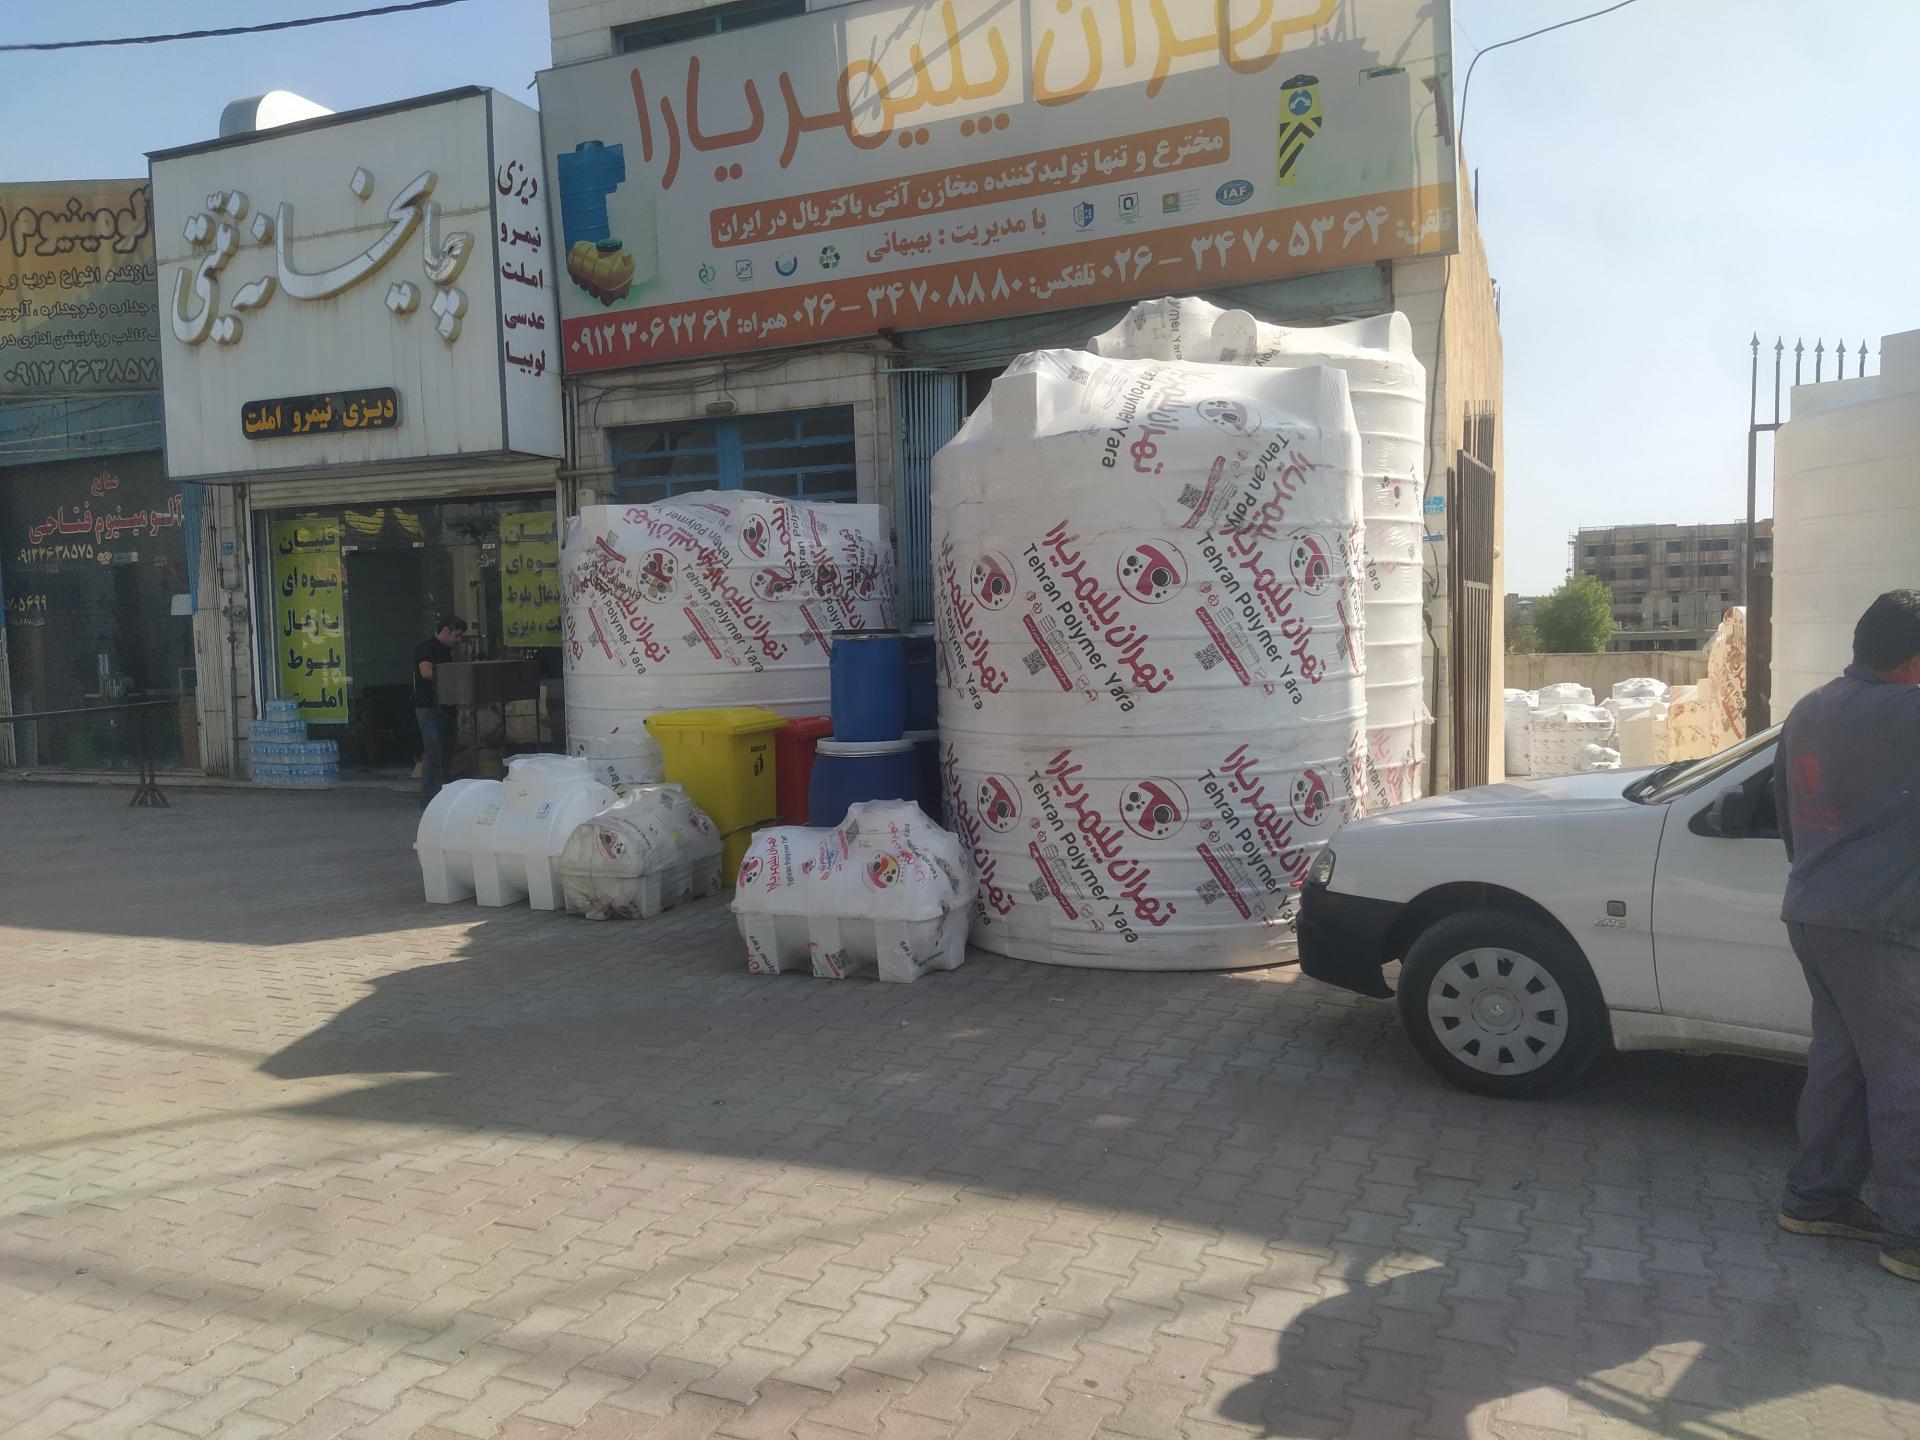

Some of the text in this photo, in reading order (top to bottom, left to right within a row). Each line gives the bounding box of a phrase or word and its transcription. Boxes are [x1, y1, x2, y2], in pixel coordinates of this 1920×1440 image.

[630, 55, 765, 190] یارا
[1093, 143, 1128, 173] تنها
[1135, 153, 1147, 172] و
[1152, 127, 1225, 171] مخترع
[497, 159, 539, 200] دیزی
[916, 176, 979, 210] مخازن
[1223, 184, 1249, 200] IAF
[791, 193, 863, 230] باکتریال
[868, 181, 909, 218] آنتی
[500, 220, 542, 249] نیمرو
[717, 210, 762, 243] ایران
[766, 214, 789, 236] در
[866, 207, 1047, 263] با مدیریت بهبهانی
[22, 271, 56, 290] درب
[60, 265, 101, 290] انواع
[502, 261, 544, 290] املت
[0, 299, 32, 322] آلومی
[110, 299, 149, 317] جداره
[504, 311, 546, 332] عدسی
[1168, 299, 1181, 333] ymer
[18, 331, 52, 349] اداری
[53, 329, 101, 349] پارتیشن
[111, 328, 147, 346] کاذب
[59, 356, 158, 385] ۲۶۳۸۵۷
[505, 340, 547, 377] لوبیا
[1255, 347, 1281, 367] Poly
[245, 397, 395, 434] دیزی نیمرو املت
[1101, 381, 1153, 470] Polymer Yara
[1129, 411, 1180, 475] تهران
[90, 471, 120, 497] صنایع
[1225, 433, 1290, 529] Tehran Poly
[505, 522, 558, 548] لیان
[665, 509, 707, 535] Polymer
[790, 504, 801, 537] Polym
[708, 531, 733, 569] Tehran
[282, 567, 338, 598] میوه ای
[1366, 560, 1382, 592] Yara
[681, 563, 712, 601] Tehran
[708, 599, 746, 645] Polymer
[744, 645, 764, 673] Yara
[823, 598, 845, 632] Polym
[1043, 518, 1175, 694] تهران پلیمر یارا
[1196, 532, 1242, 594] Tehran
[1235, 591, 1284, 663] Polymer
[1279, 663, 1303, 706] Yara
[1239, 550, 1328, 685] تهران پلیمر
[603, 599, 647, 675] Polymer Yara
[629, 615, 671, 662] تهران
[743, 613, 788, 661] تهران
[1022, 542, 1062, 603] Tehran
[1057, 600, 1109, 672] Polymer
[1104, 671, 1135, 713] Yara
[287, 647, 341, 677] بلوط
[964, 629, 1009, 694] تهران
[965, 672, 983, 711] Yara
[1733, 690, 1746, 712] Poly
[1045, 748, 1083, 798] یارا
[1220, 743, 1259, 793] یارا
[1365, 753, 1381, 790] ehran
[1065, 792, 1125, 864] پلیمر
[1197, 768, 1241, 830] Tehran
[1235, 827, 1282, 896] Polymer
[1240, 785, 1293, 858] پلیمر
[1026, 769, 1065, 833] Tehran
[1059, 831, 1110, 902] Polymer
[1107, 903, 1139, 944] Yara
[973, 848, 1016, 915] تهران
[1107, 857, 1177, 927] تهران
